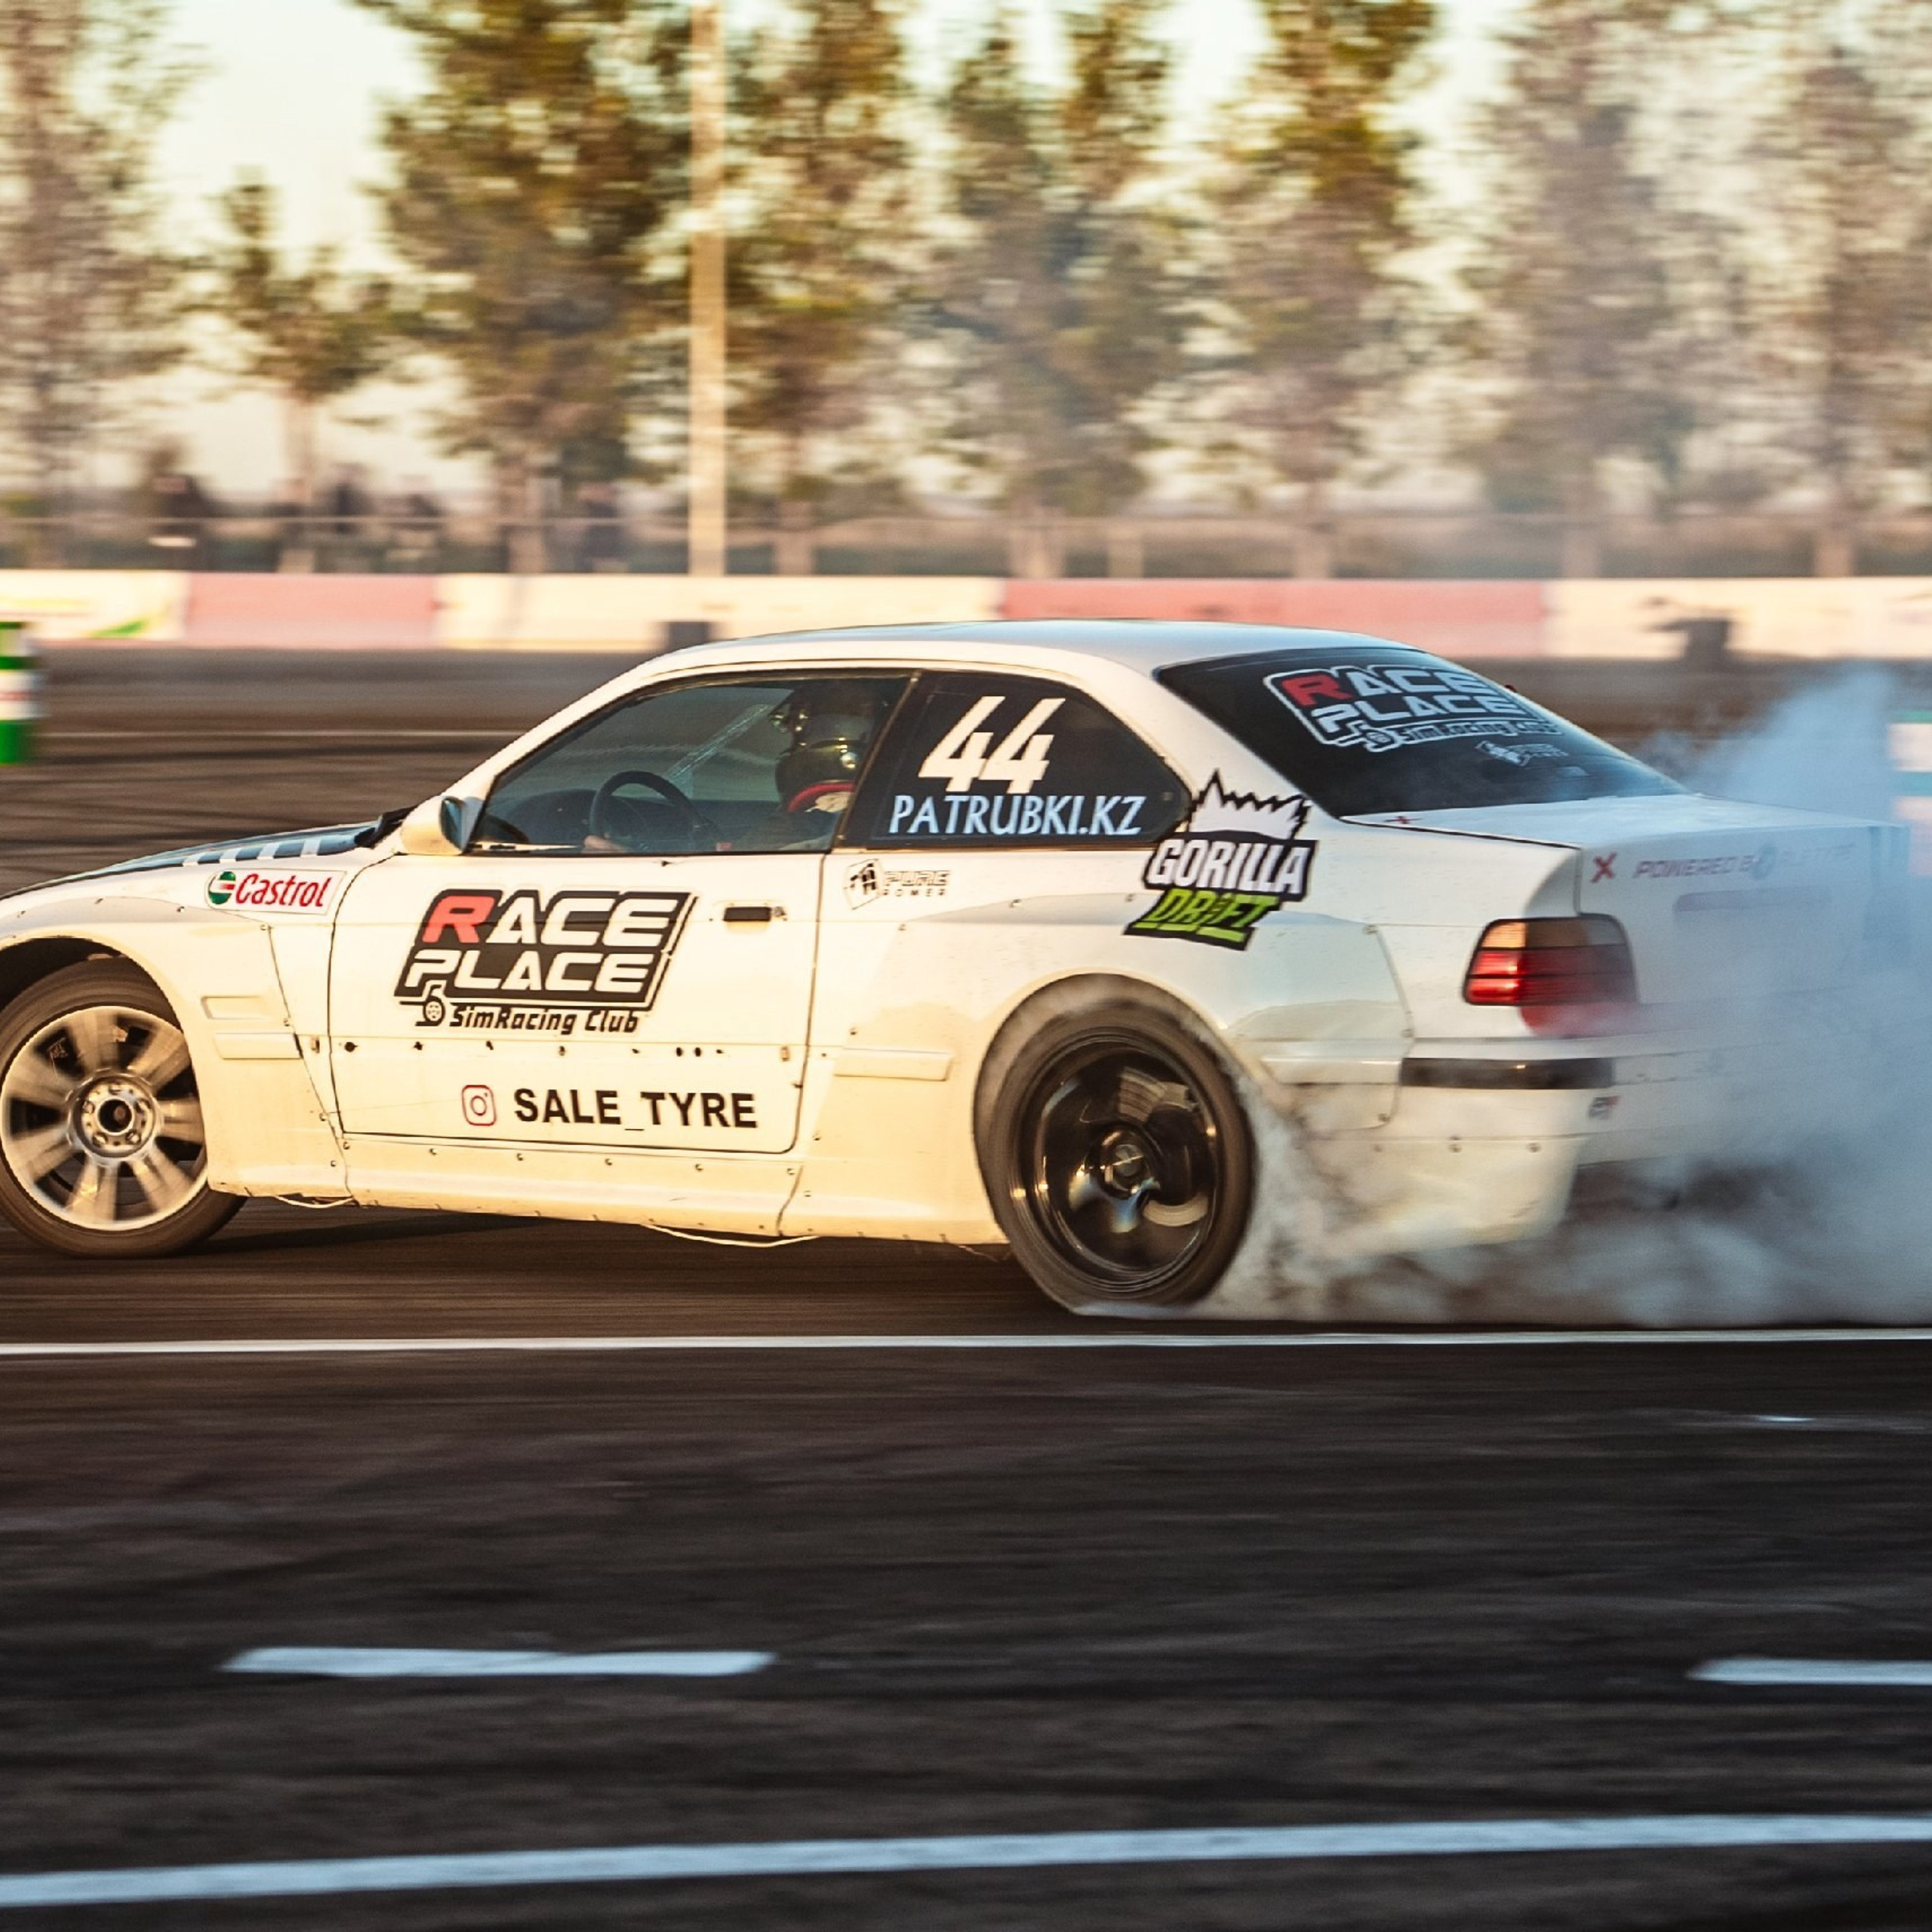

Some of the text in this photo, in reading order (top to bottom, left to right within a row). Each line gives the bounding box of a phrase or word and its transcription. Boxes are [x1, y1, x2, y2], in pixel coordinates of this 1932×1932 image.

[1281, 667, 1496, 706] RACE
[1310, 694, 1528, 733] PLACE
[918, 695, 1066, 794] 44
[888, 795, 1147, 835] PATRUBKI.KZ
[1146, 838, 1312, 894] GORILLA
[1632, 856, 1737, 879] POWERED
[235, 873, 333, 907] Castrol
[421, 895, 679, 947] RACE
[404, 949, 655, 993] PLACE
[450, 1004, 639, 1035] SimRacing Club
[514, 1088, 758, 1131] SALE_TYRE
